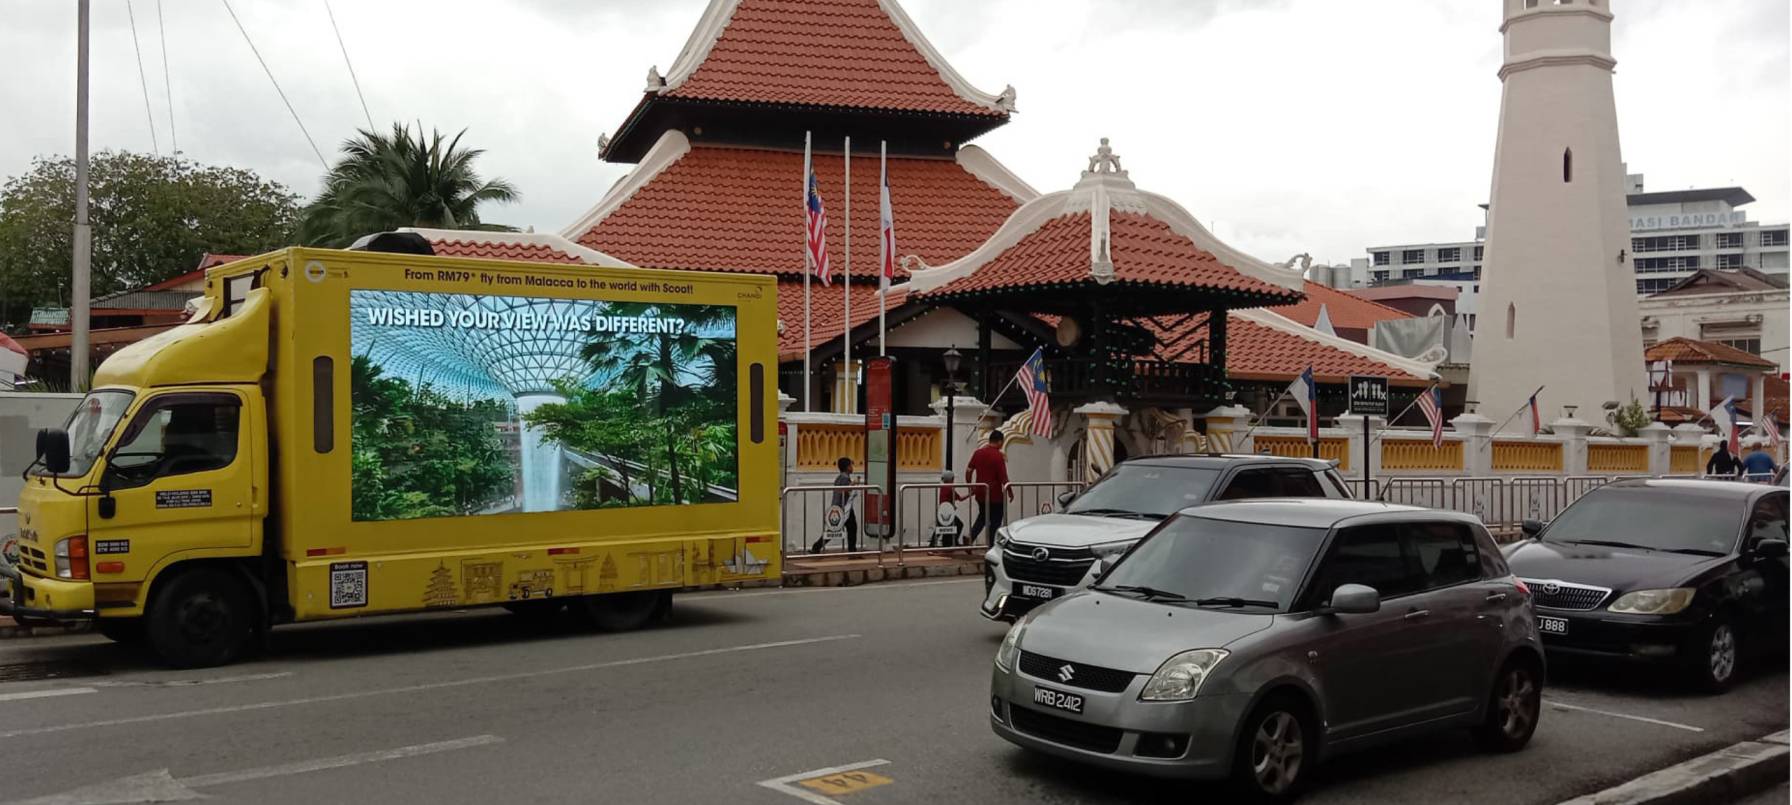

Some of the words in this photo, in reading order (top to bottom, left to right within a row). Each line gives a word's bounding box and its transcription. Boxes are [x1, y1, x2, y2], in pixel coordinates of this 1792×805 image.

[404, 268, 434, 281] From
[480, 272, 493, 285] fly
[497, 274, 522, 285] from
[525, 275, 573, 288] Malacca
[577, 278, 587, 289] to
[590, 278, 606, 289] the
[609, 281, 637, 291] world
[640, 282, 660, 292] with
[662, 283, 693, 294] Scoot!
[368, 307, 444, 327] WISHED
[447, 310, 500, 329] YOUR
[501, 312, 549, 331] VIEW
[552, 316, 591, 332] WAS
[595, 316, 685, 334] DIFFERENT?
[1545, 619, 1565, 632] 888
[1034, 687, 1055, 706] WRB
[1056, 693, 1081, 712] 2412
